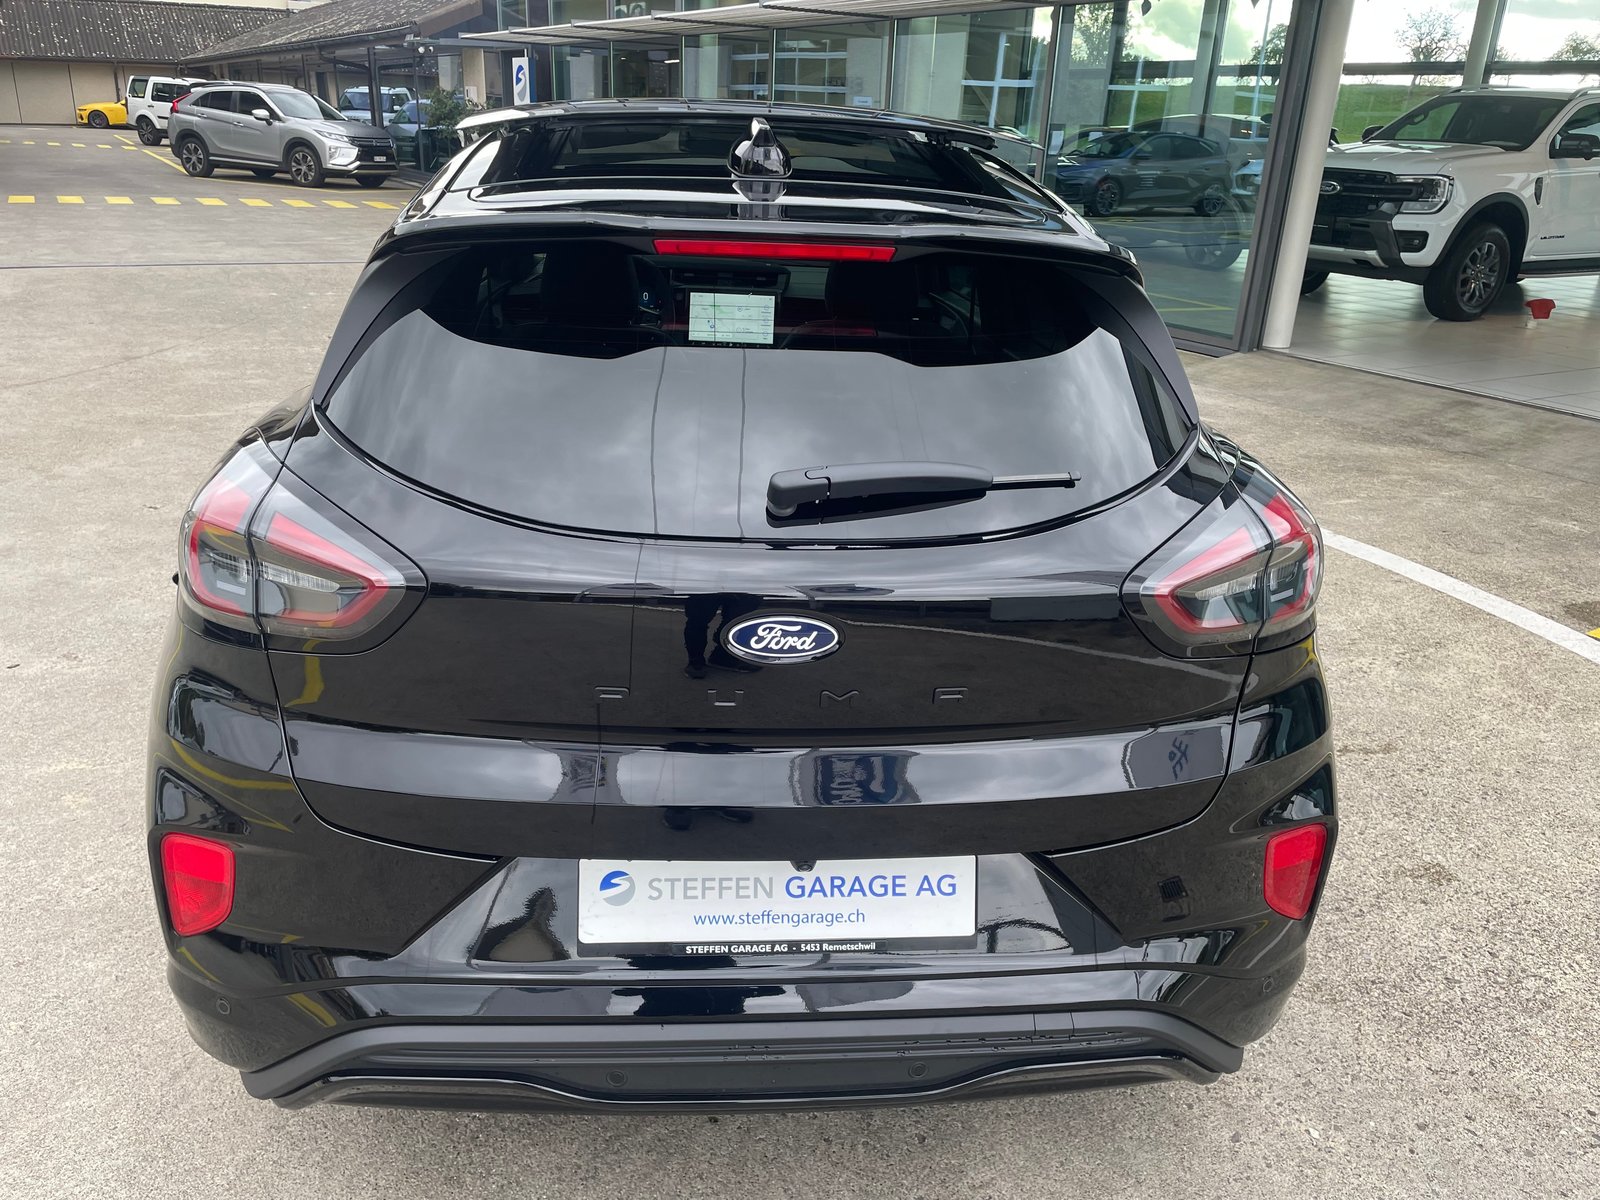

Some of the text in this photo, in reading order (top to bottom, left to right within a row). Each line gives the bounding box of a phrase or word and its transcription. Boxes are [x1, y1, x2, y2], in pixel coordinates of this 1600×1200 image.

[750, 623, 818, 650] Ford
[594, 686, 969, 708] PUMA
[648, 874, 957, 900] STEFFEN GARAGE AG
[693, 909, 865, 927] www.steffengarage.ch
[685, 945, 729, 954] STEFFEN
[731, 944, 772, 953] GARAGE
[774, 944, 788, 952] AG
[800, 943, 820, 951] 5453
[822, 942, 876, 951] Remetschwil
